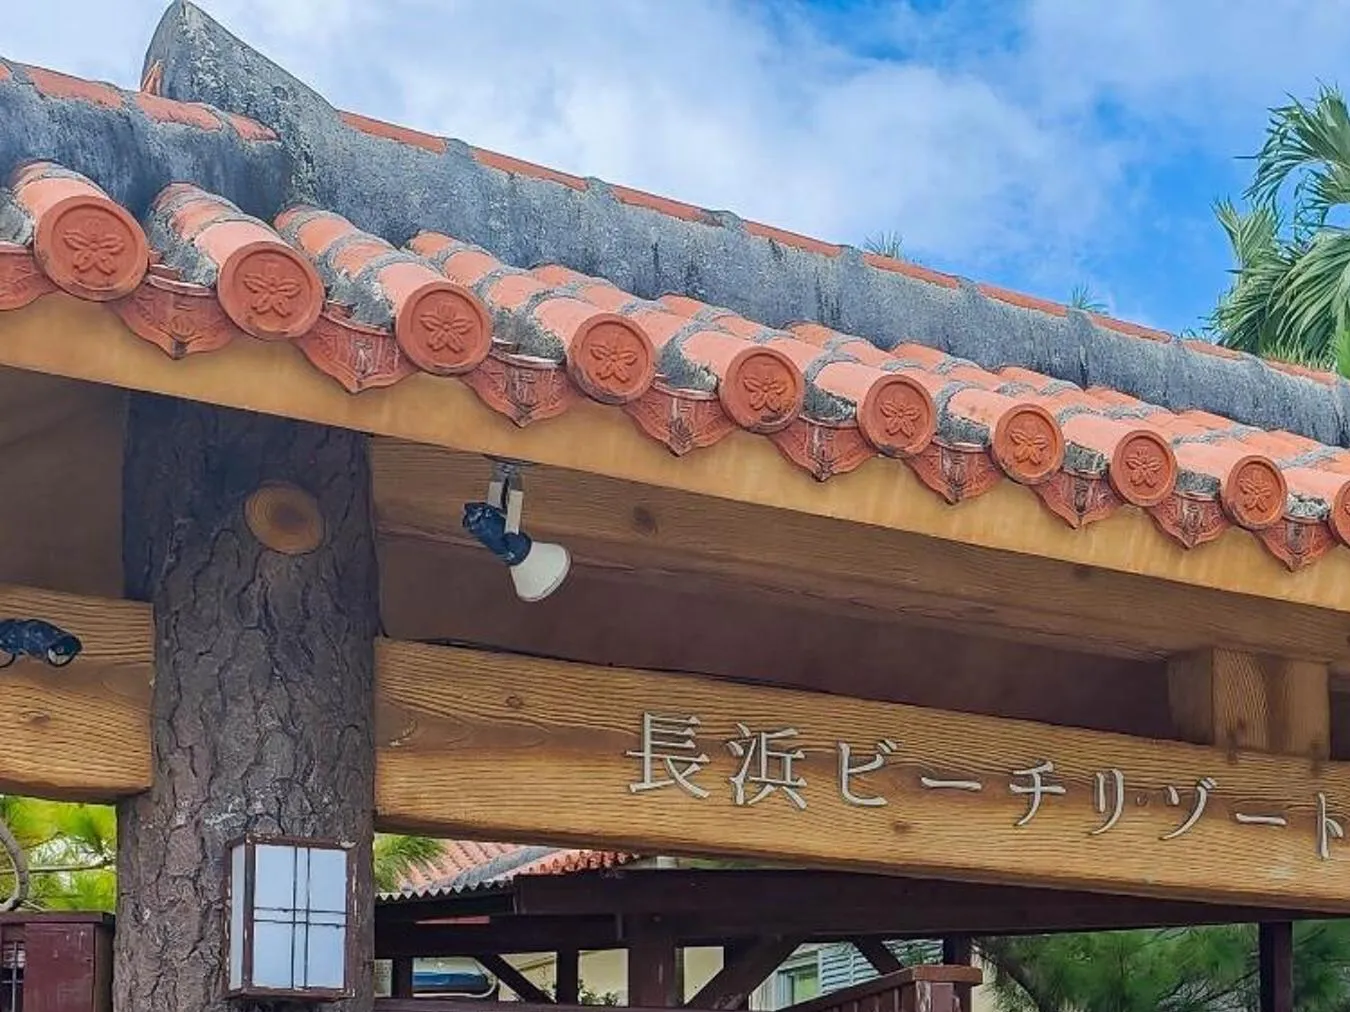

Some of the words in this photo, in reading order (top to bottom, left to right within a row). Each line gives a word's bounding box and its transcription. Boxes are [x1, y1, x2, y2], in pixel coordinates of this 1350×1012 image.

[626, 711, 1345, 861] 長浜ビーチリゾート
